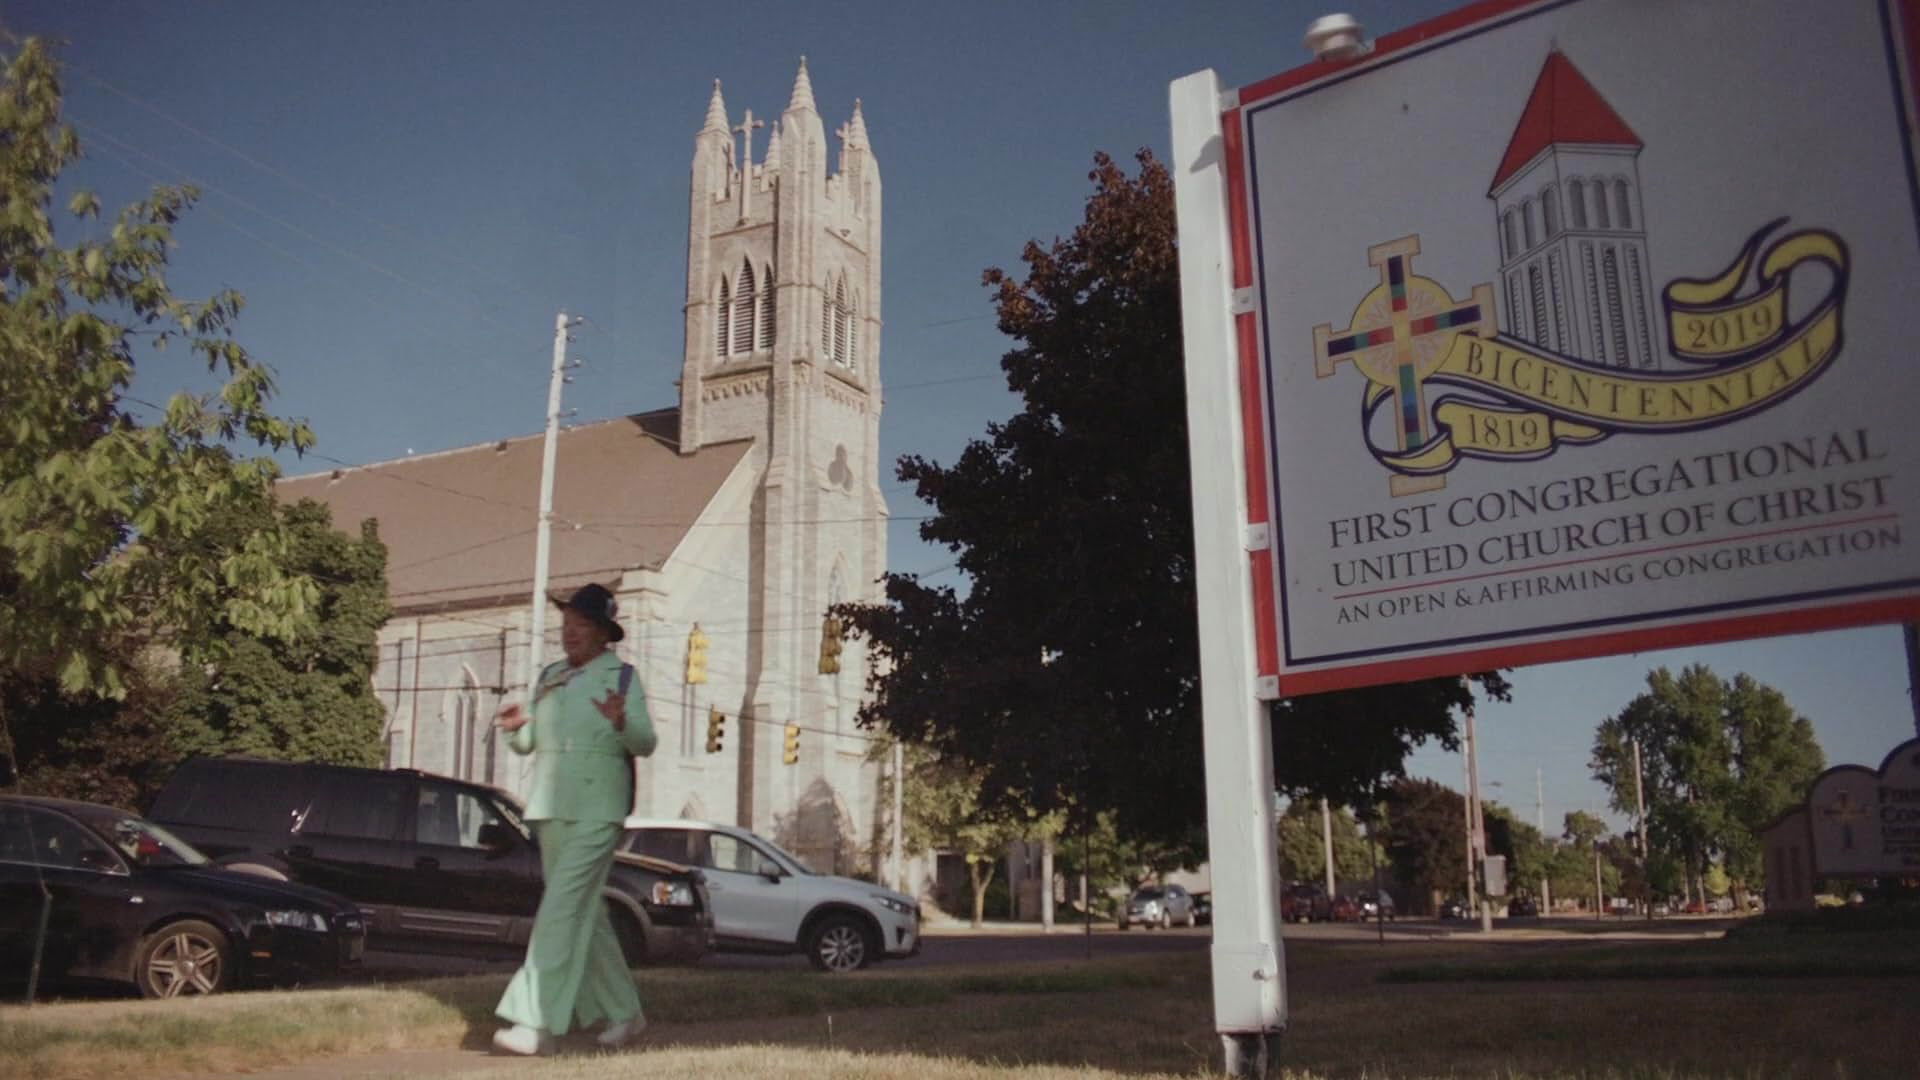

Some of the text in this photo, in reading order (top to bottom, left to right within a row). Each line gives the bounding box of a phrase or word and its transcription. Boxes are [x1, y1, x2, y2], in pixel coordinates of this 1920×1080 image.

[1687, 304, 1773, 349] 2019
[1464, 337, 1826, 417] BICENTENNIAL
[1468, 413, 1538, 448] 1819
[1328, 429, 1889, 549] FIRST CONGREGATIONAL
[1333, 475, 1893, 587] UNITED CHURCH OF CHRIST
[1337, 525, 1901, 625] AN OPEN & AFFIRMING CONGREGATION
